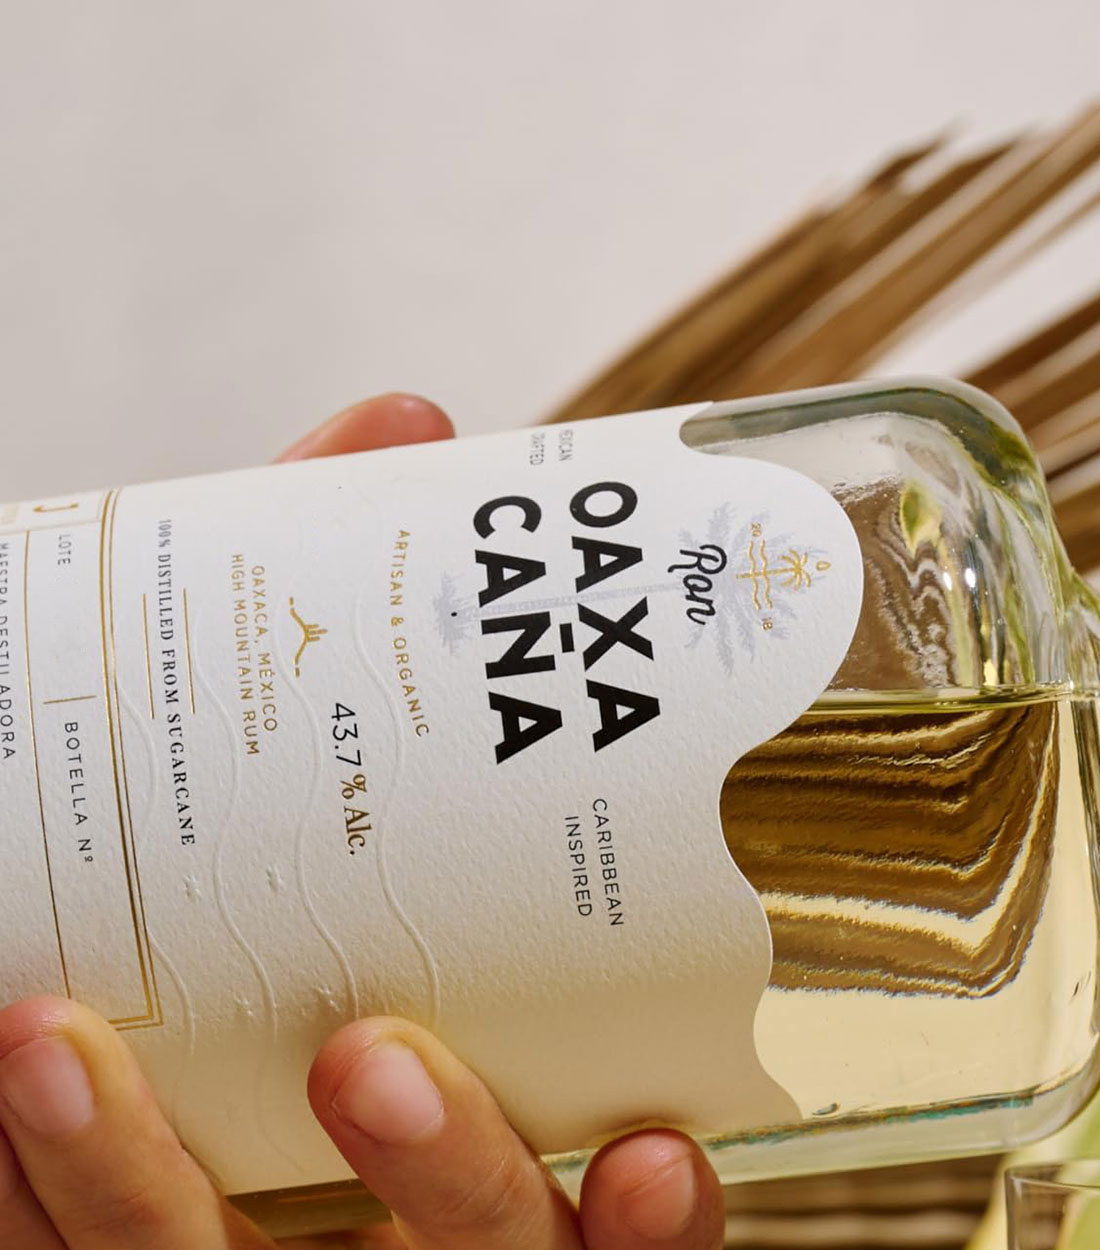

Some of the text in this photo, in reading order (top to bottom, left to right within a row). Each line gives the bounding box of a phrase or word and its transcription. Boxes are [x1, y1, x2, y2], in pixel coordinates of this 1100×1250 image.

[58, 534, 72, 565] LOTE
[667, 544, 727, 626] Ron
[231, 554, 260, 755] HIGH MOUNTAIN RUM
[251, 565, 278, 731] OAXACA, MÉXICO
[390, 529, 429, 737] ARTISAN & ORGANIC
[473, 495, 575, 765] CAÑA
[569, 481, 661, 752] OAXA
[762, 616, 773, 631] 18
[158, 519, 195, 845] 100% DISTILLED FROM SUGARCANE
[64, 721, 88, 826] BOTELLA
[344, 806, 372, 856] Alc.
[564, 816, 593, 917] INSPIRED
[592, 798, 624, 926] CARIBBEAN
